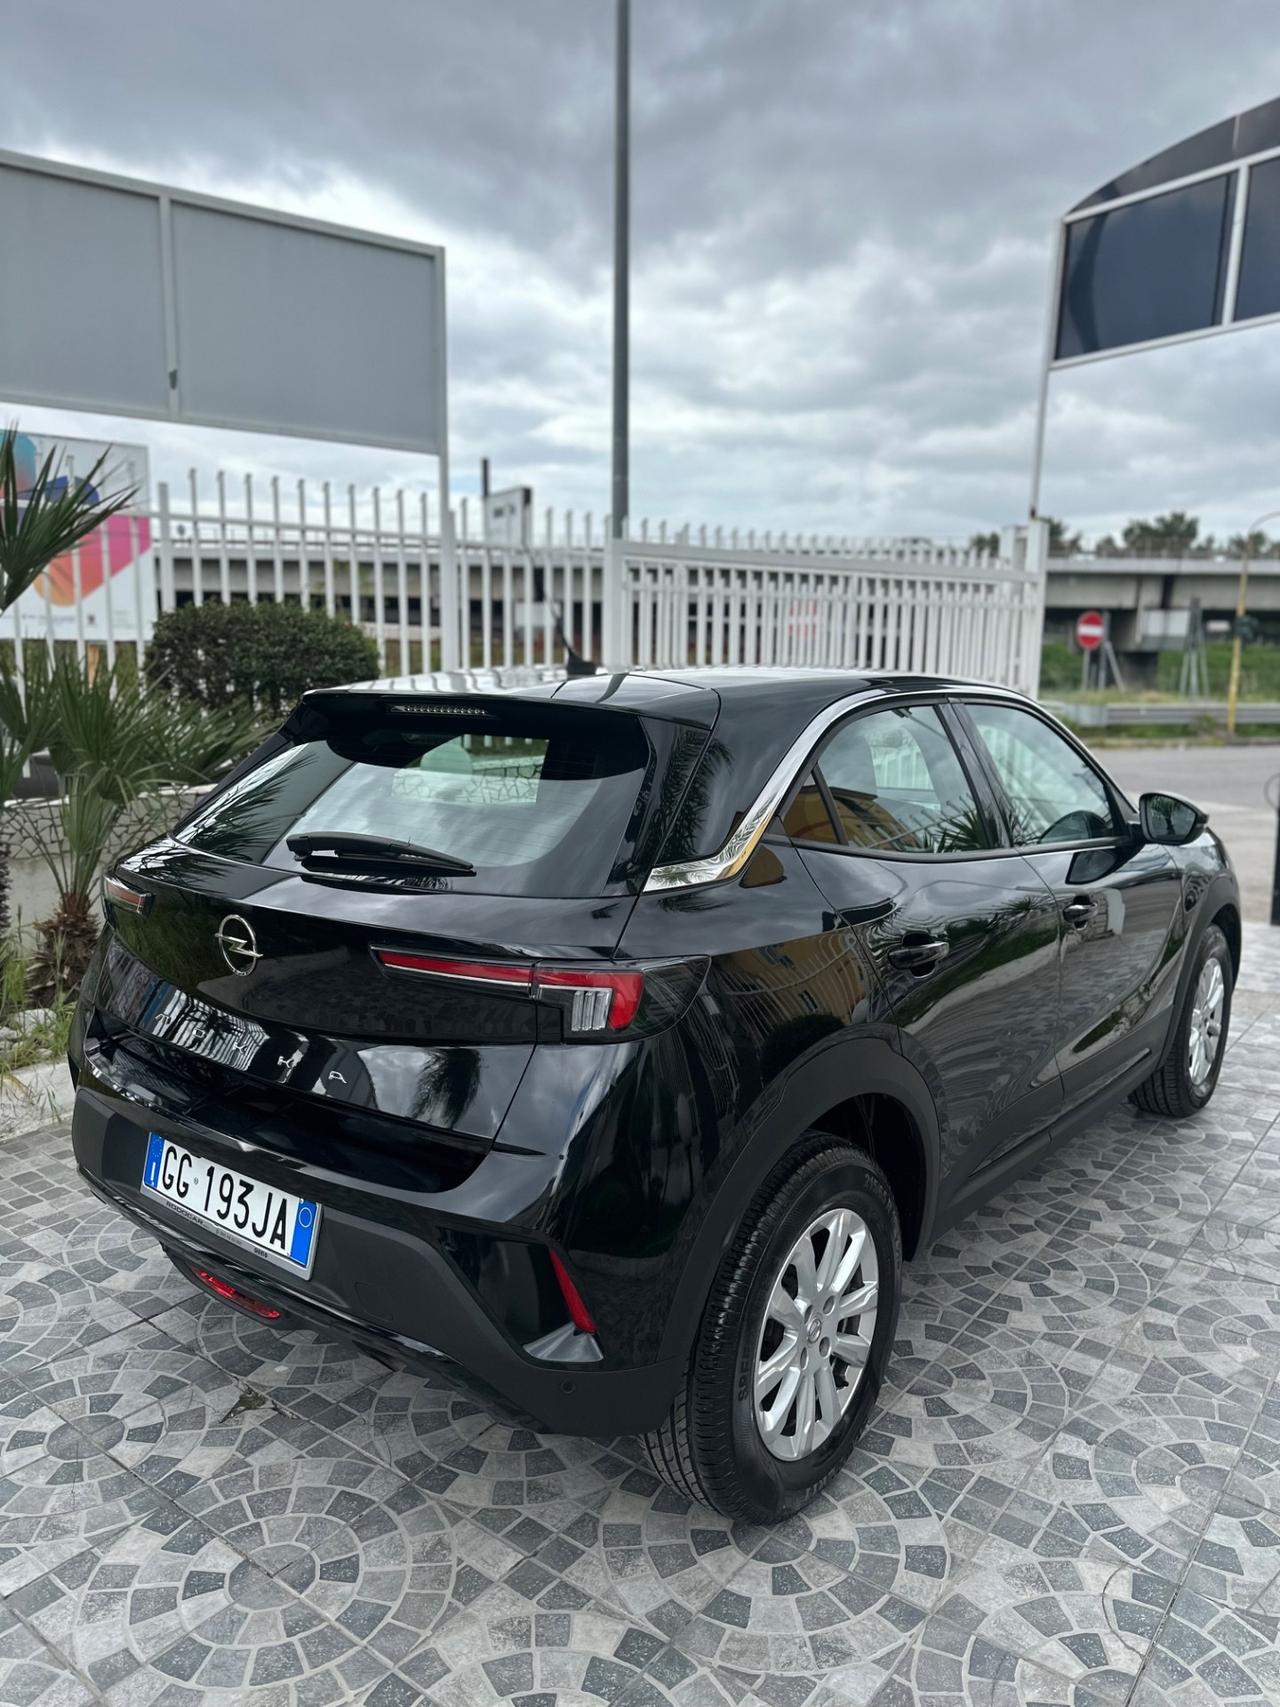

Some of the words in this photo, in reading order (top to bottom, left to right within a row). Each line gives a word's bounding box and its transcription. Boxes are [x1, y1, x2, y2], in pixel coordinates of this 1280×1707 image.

[155, 1013, 347, 1084] MOKKA
[162, 1146, 192, 1198] GG
[203, 1166, 288, 1250] 193JA
